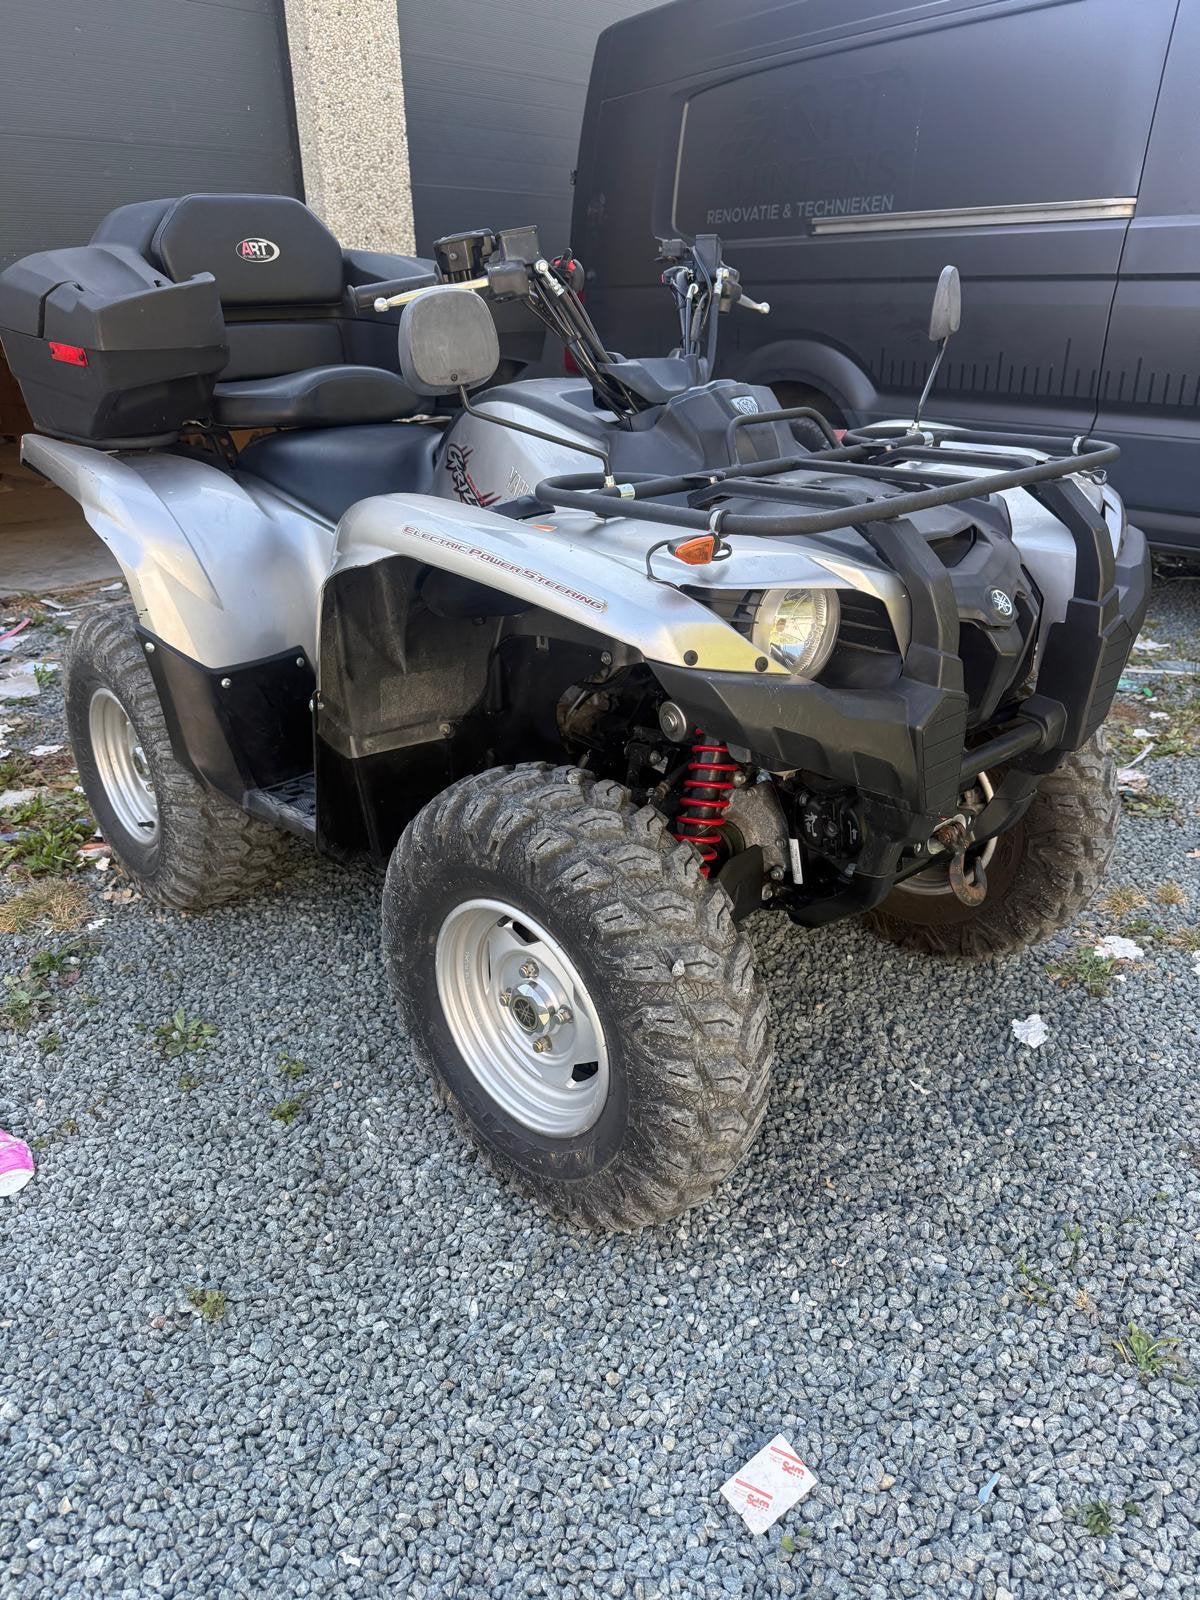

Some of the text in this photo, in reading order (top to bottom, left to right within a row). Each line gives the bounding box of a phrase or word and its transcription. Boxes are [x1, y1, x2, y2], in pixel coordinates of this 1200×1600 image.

[707, 195, 895, 225] RENOVATIE & TECHNIEKEN
[241, 240, 267, 256] ART
[403, 526, 602, 611] ELECTRIC POWER STEERING
